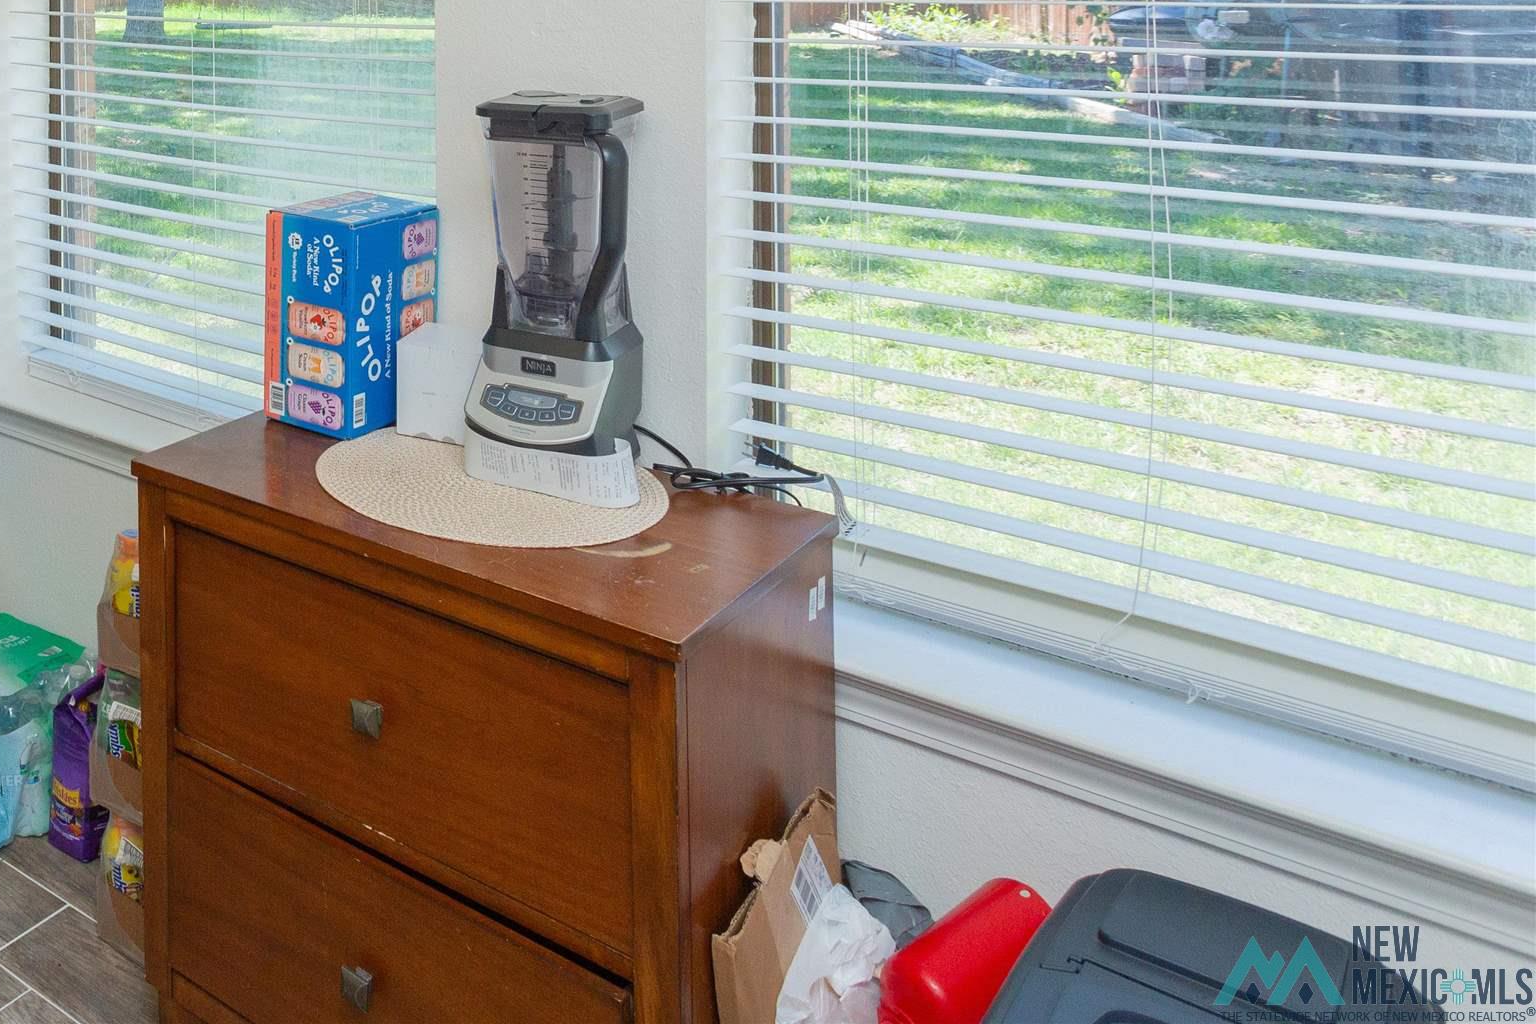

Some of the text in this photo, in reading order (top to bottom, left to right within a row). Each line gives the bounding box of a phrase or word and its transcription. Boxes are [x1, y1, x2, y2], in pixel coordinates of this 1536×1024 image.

[322, 234, 342, 294] OLIPOP
[321, 308, 338, 343] OLIPOP
[355, 274, 382, 382] OLIPOP
[526, 360, 552, 374] NINJA
[321, 393, 335, 426] OLIPOP
